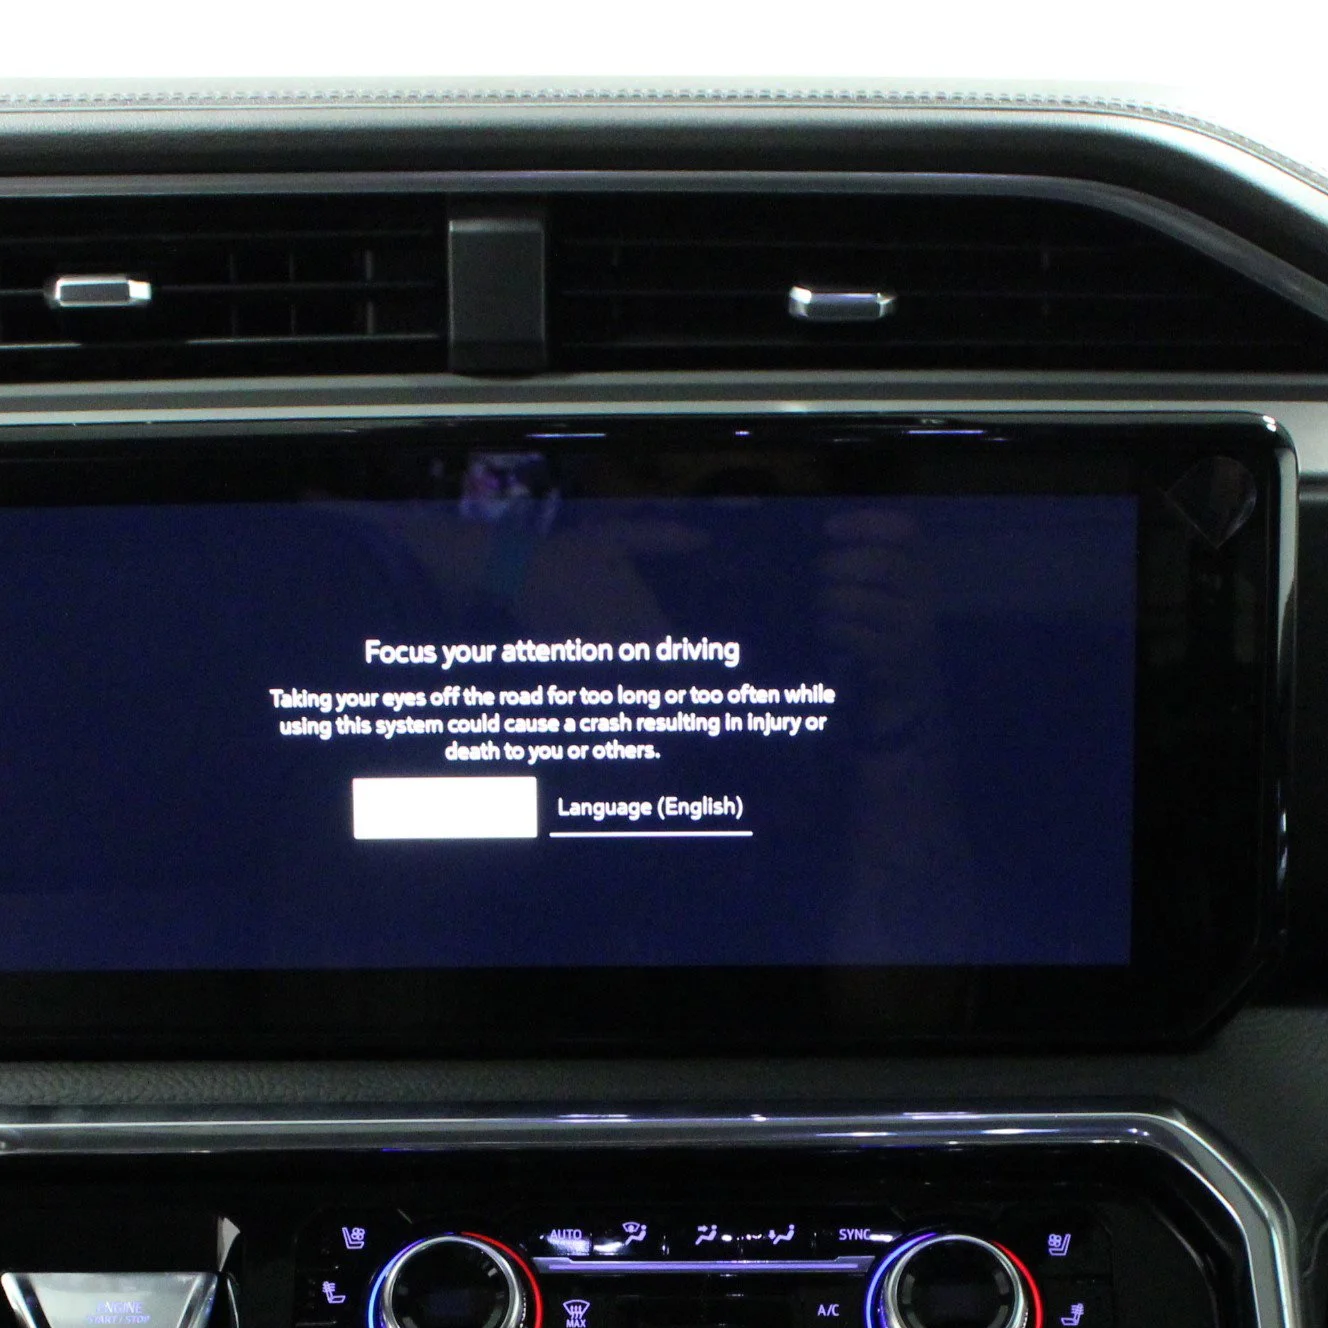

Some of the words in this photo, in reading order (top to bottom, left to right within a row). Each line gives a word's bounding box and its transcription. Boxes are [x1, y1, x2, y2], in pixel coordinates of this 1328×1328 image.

[365, 639, 437, 664] Focus
[441, 643, 496, 670] your
[501, 637, 613, 663] attention
[618, 642, 650, 662] on
[656, 635, 740, 669] driving
[269, 688, 332, 713] Taking
[335, 692, 379, 713] your
[382, 692, 426, 712] eyes
[430, 686, 461, 706] off
[463, 686, 495, 706] the
[499, 685, 543, 705] road
[547, 685, 577, 706] for
[580, 686, 613, 706] too
[617, 684, 660, 709] long
[664, 689, 687, 704] or
[690, 685, 723, 704] too
[727, 684, 780, 704] often
[784, 683, 836, 704] while
[279, 716, 332, 740] using
[335, 714, 372, 735] this
[375, 715, 443, 740] system
[447, 713, 500, 734] could
[504, 717, 560, 734] cause
[563, 717, 576, 732] a
[579, 712, 632, 733] crash
[636, 712, 721, 737] resulting
[724, 713, 743, 731] in
[747, 712, 802, 736] injury
[805, 716, 827, 731] or
[445, 740, 500, 761] death
[503, 742, 524, 760] to
[527, 745, 563, 765] you
[567, 744, 590, 760] or
[592, 739, 661, 760] others.
[558, 797, 652, 822] Language
[657, 795, 744, 822] (English)
[550, 1229, 582, 1241] AUTO
[839, 1229, 871, 1241] SYNC
[96, 1301, 143, 1314] ENGINE
[817, 1304, 840, 1317] A/C
[566, 1318, 586, 1328] MAX
